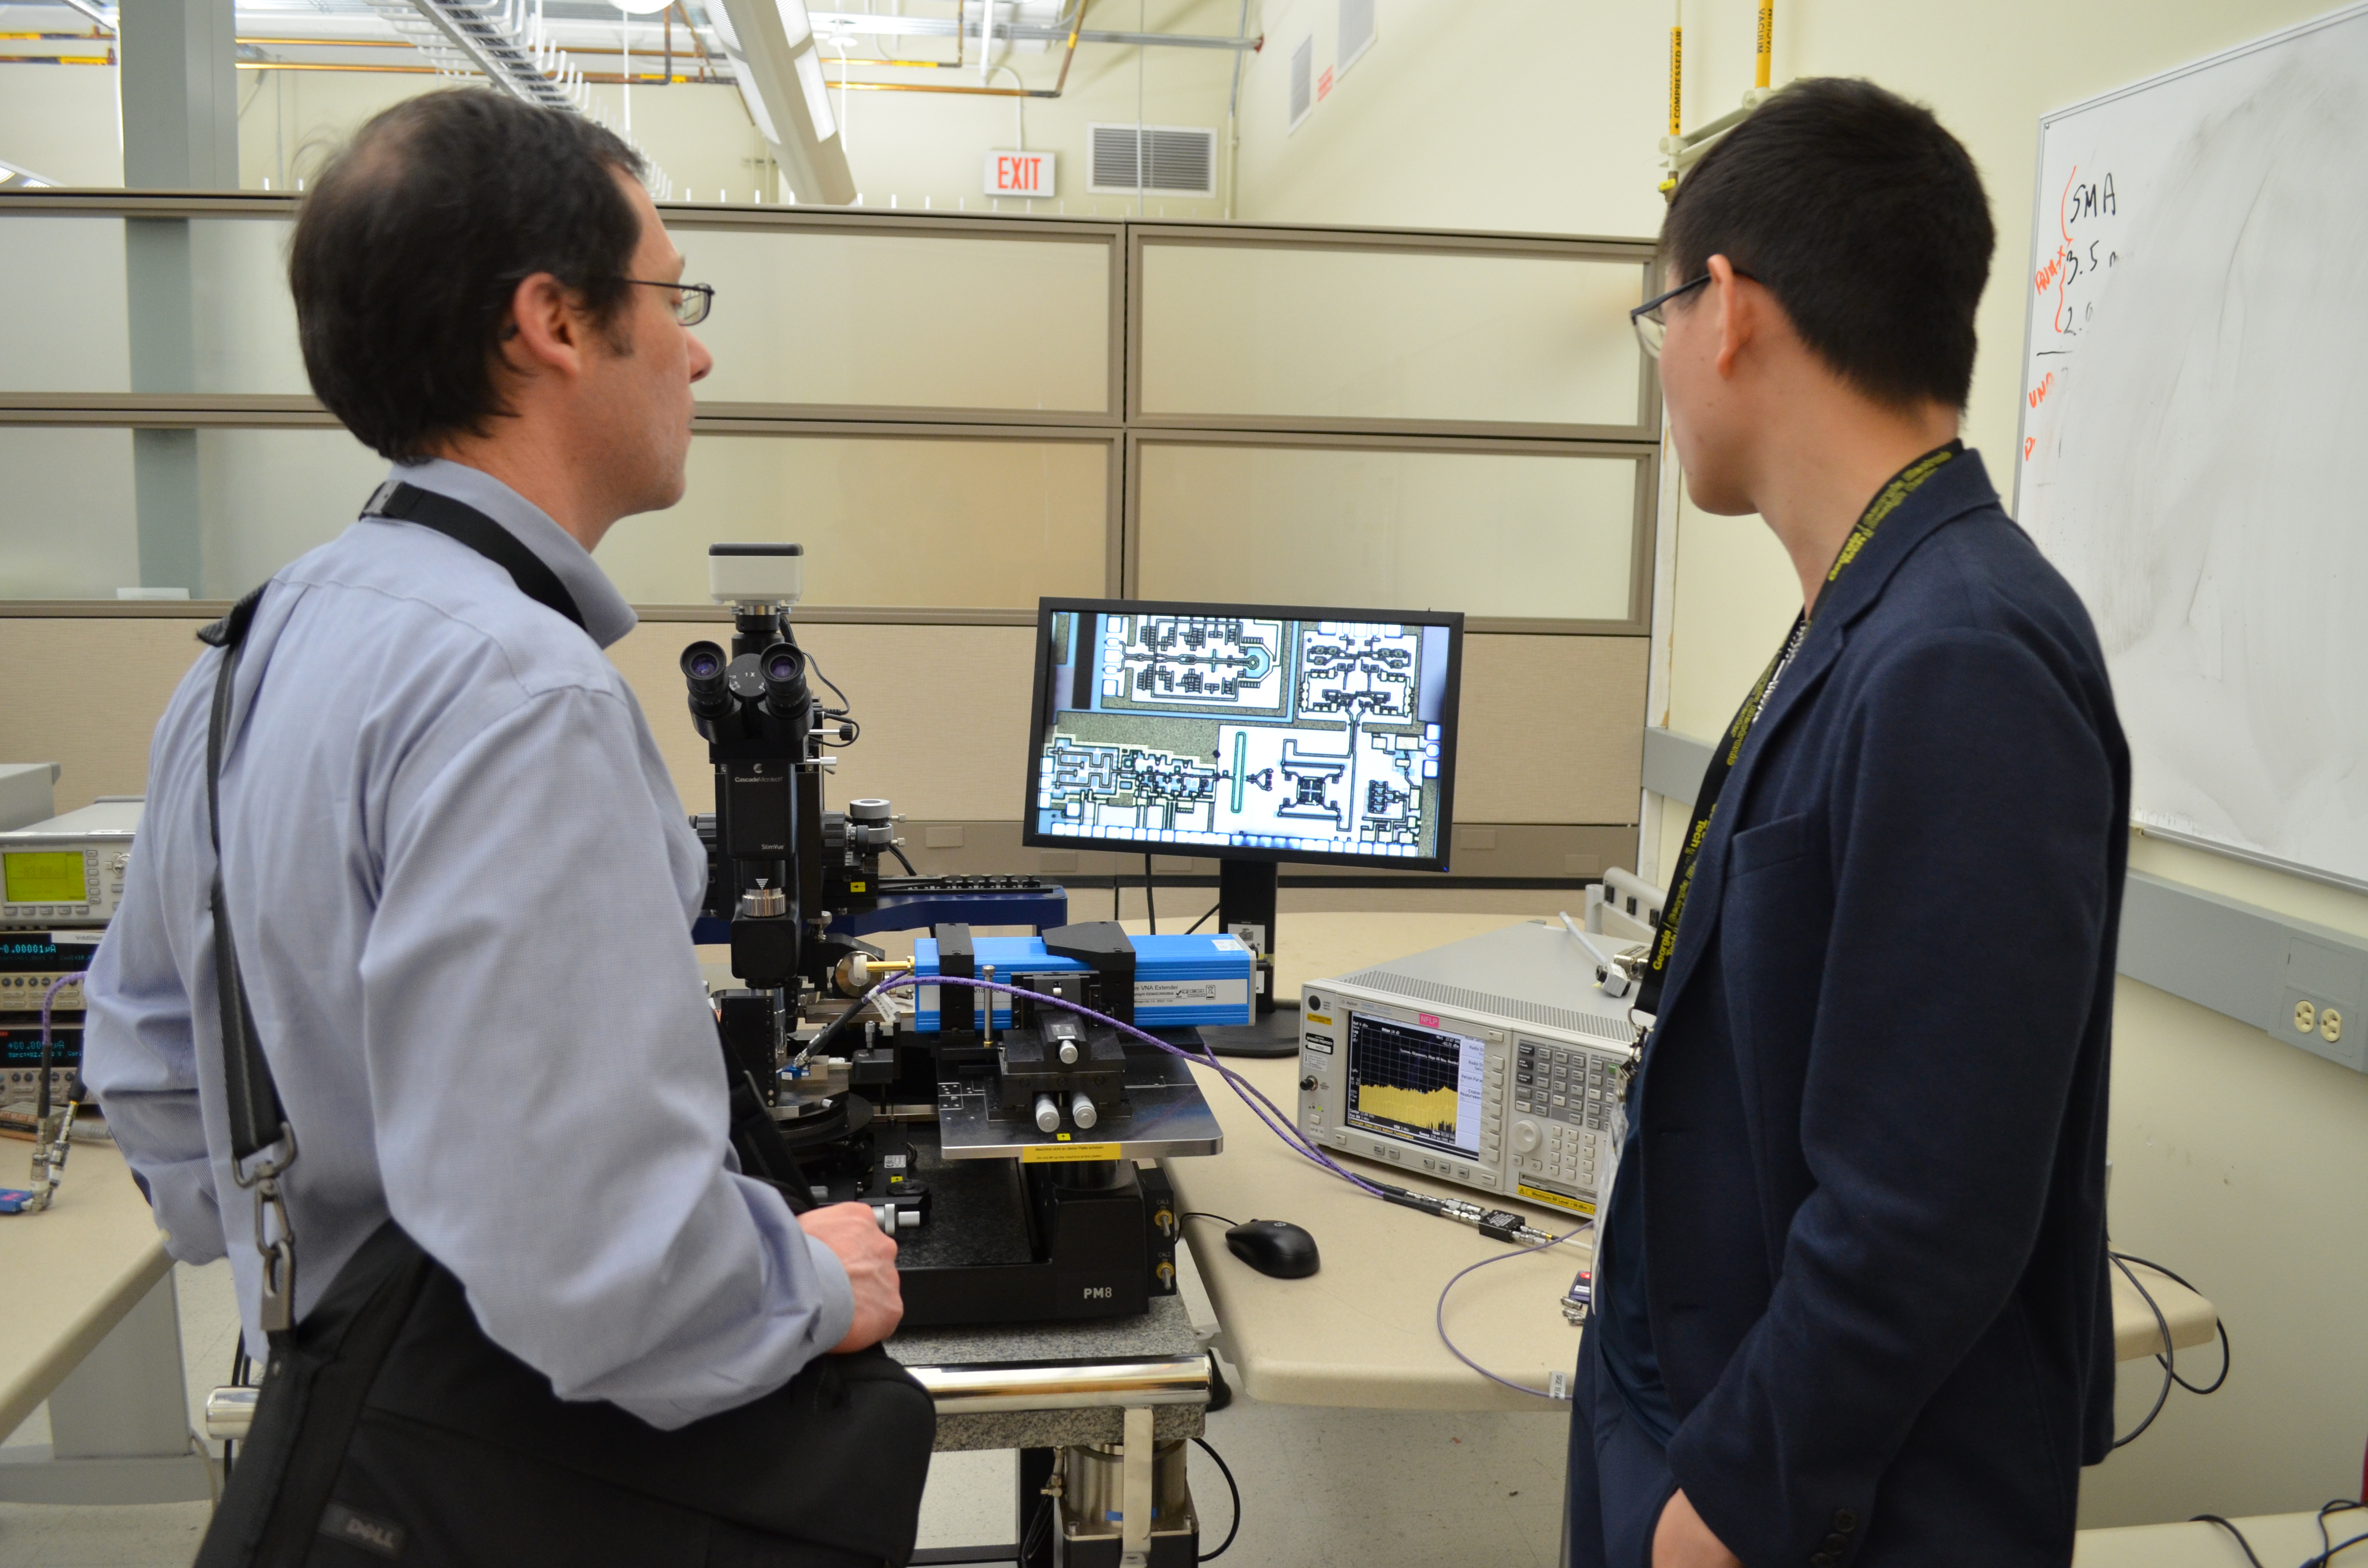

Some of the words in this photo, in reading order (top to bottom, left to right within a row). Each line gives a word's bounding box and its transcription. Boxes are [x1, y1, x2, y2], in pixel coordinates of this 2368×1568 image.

[1757, 8, 1765, 54] VACUUM
[998, 156, 1041, 190] EXIT
[2070, 172, 2116, 223] SMA
[2067, 240, 2099, 285] 3.5
[1652, 929, 1672, 970] Georgia
[1420, 1015, 1438, 1025] NFLP
[1084, 1287, 1112, 1299] PM8
